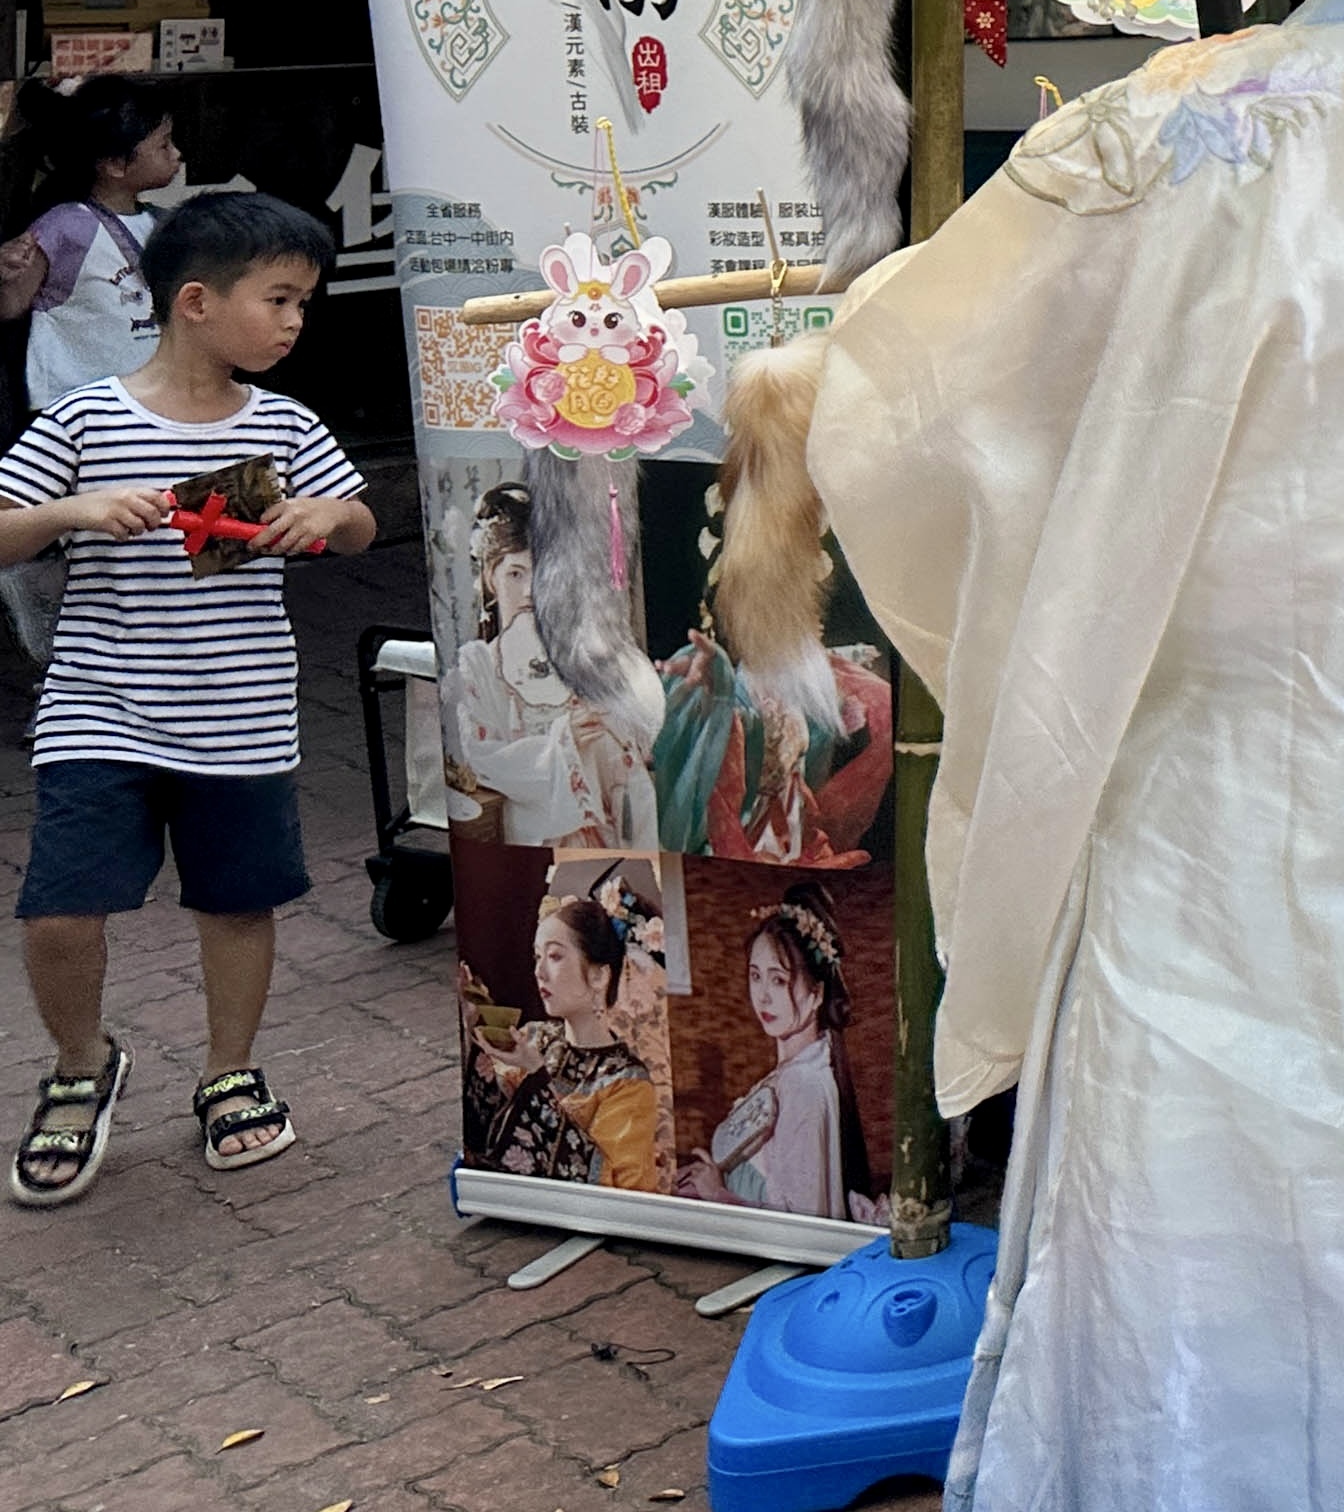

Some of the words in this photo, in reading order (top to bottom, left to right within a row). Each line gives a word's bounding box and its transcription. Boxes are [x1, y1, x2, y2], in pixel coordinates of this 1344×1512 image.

[636, 43, 666, 95] 出租
[426, 202, 482, 219] 全省服務
[779, 202, 824, 218] 服裝出
[780, 231, 825, 247] 寫真拍
